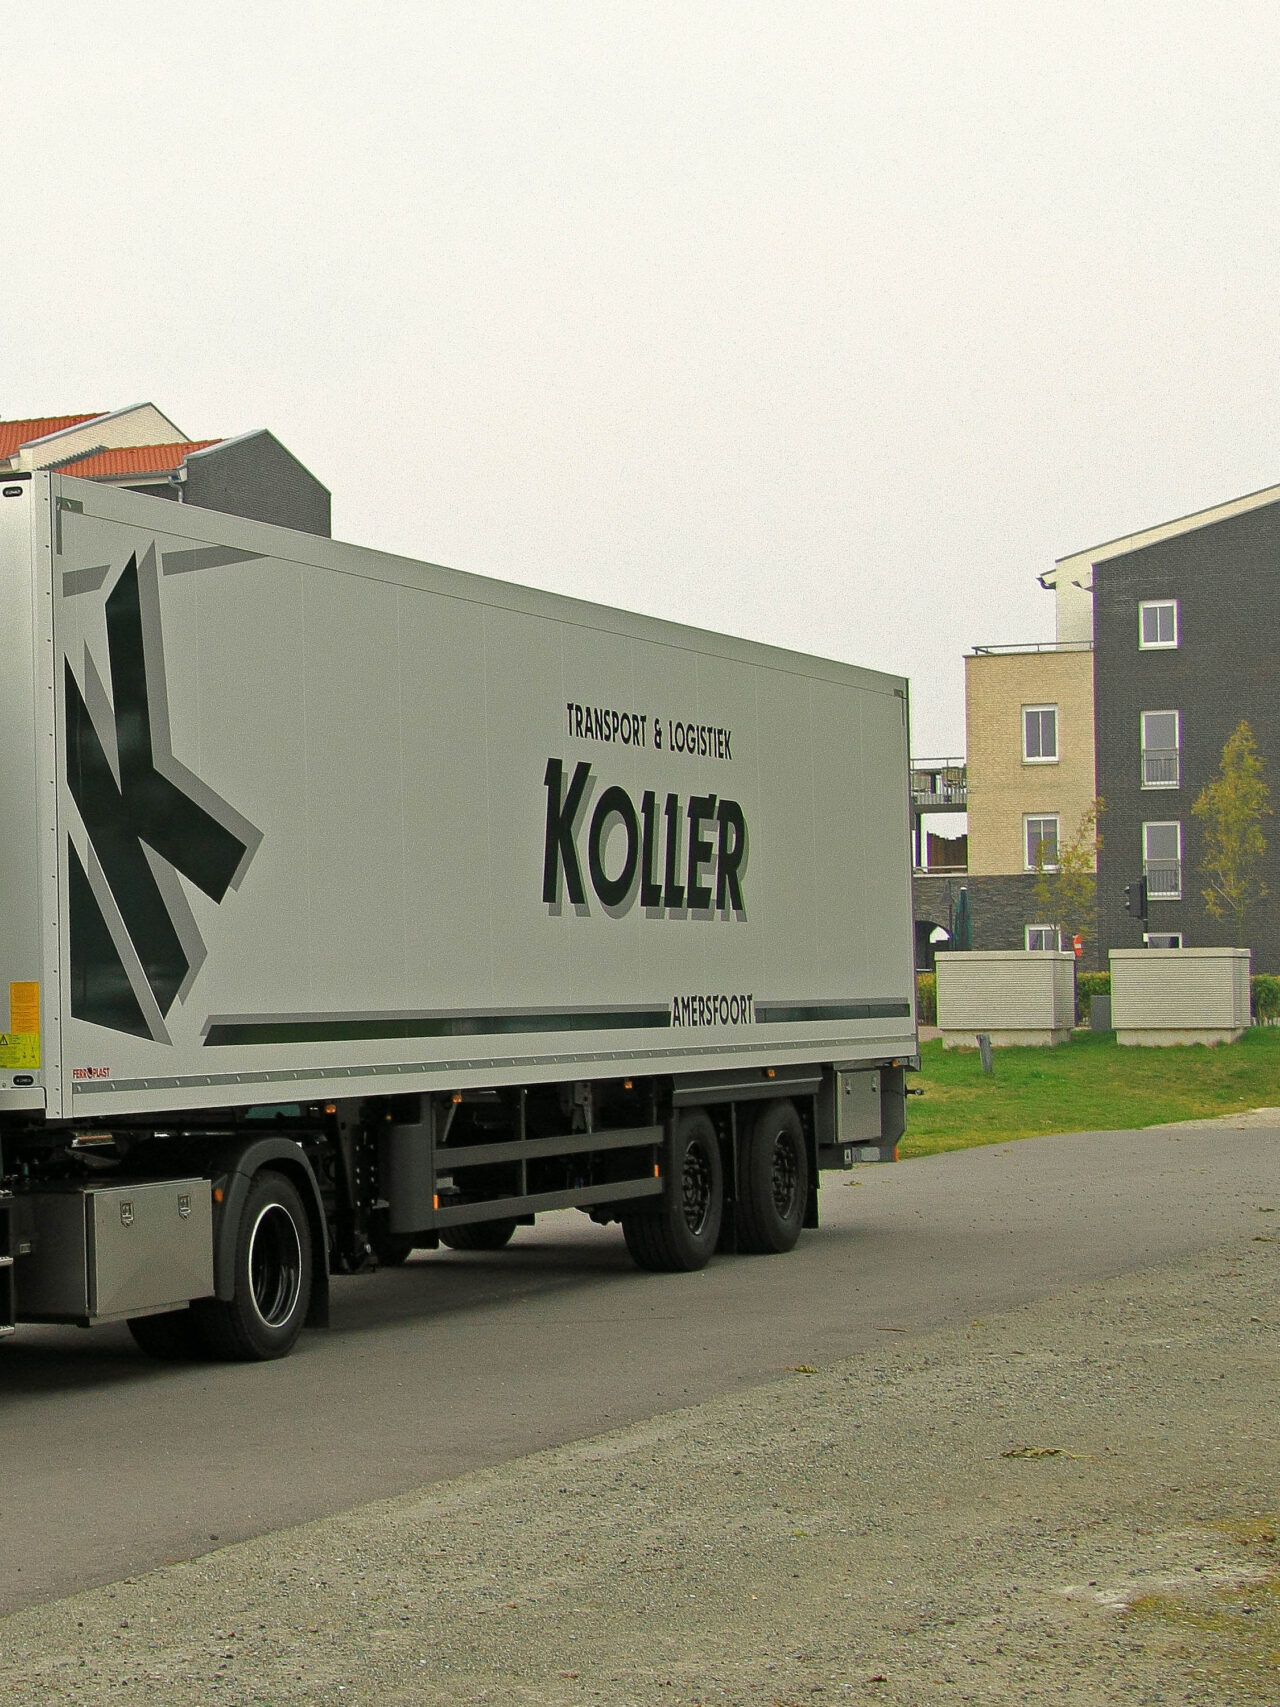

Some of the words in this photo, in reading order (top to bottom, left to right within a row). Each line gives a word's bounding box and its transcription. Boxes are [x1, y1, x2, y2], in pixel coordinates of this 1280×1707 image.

[566, 702, 647, 747] TRANSPORT
[654, 717, 662, 750] &
[669, 719, 732, 760] LOGISTIEK
[542, 757, 750, 922] KOLLER
[672, 993, 753, 1027] AMERSFOORT
